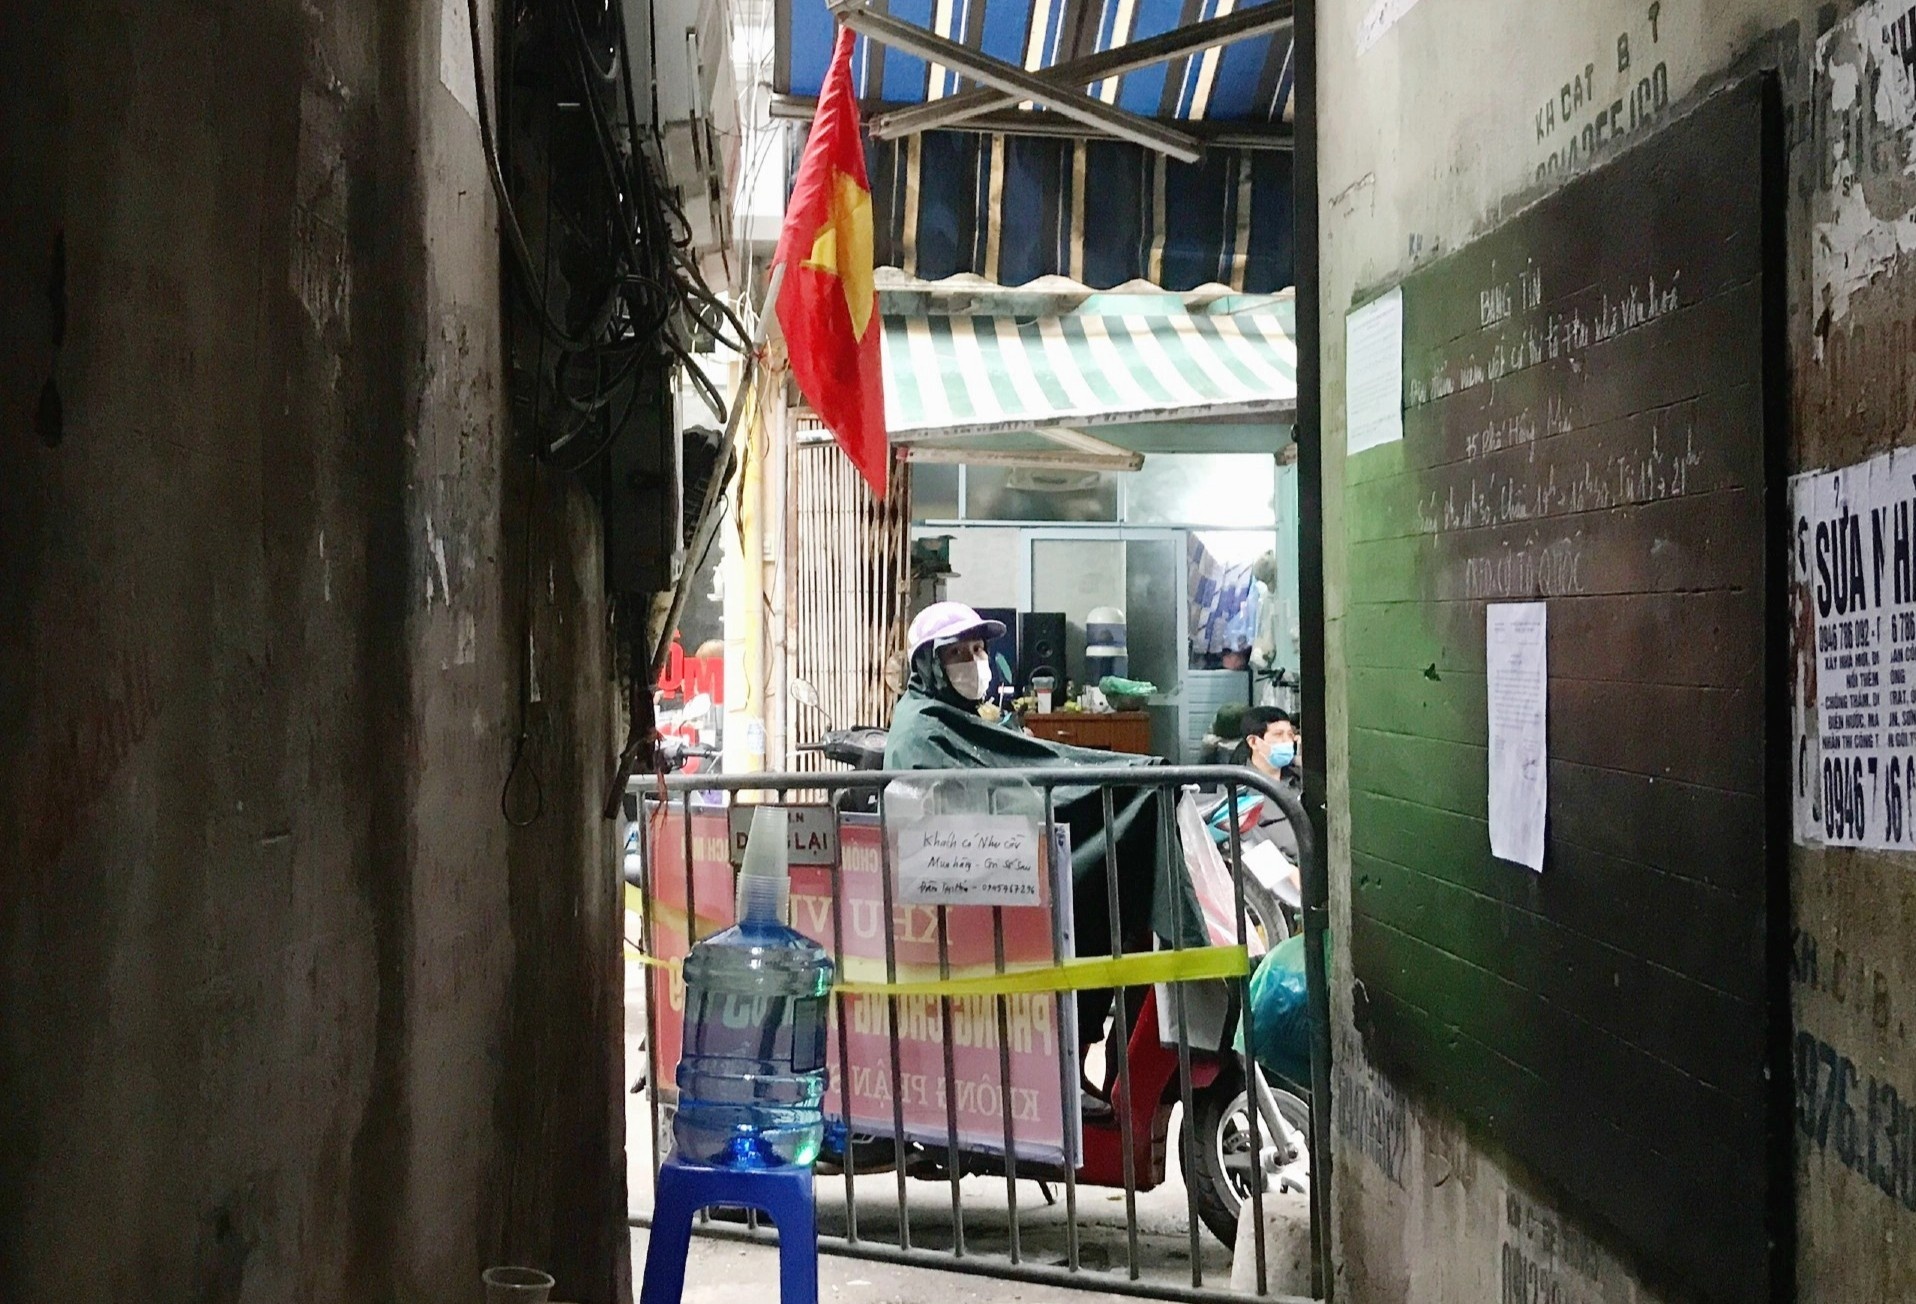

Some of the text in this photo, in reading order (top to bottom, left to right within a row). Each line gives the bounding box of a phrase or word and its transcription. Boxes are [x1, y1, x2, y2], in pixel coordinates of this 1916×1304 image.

[1815, 476, 1866, 618] SỬA
[1871, 495, 1916, 608] NH
[1823, 757, 1865, 839] 0946
[794, 831, 828, 856] LẠI
